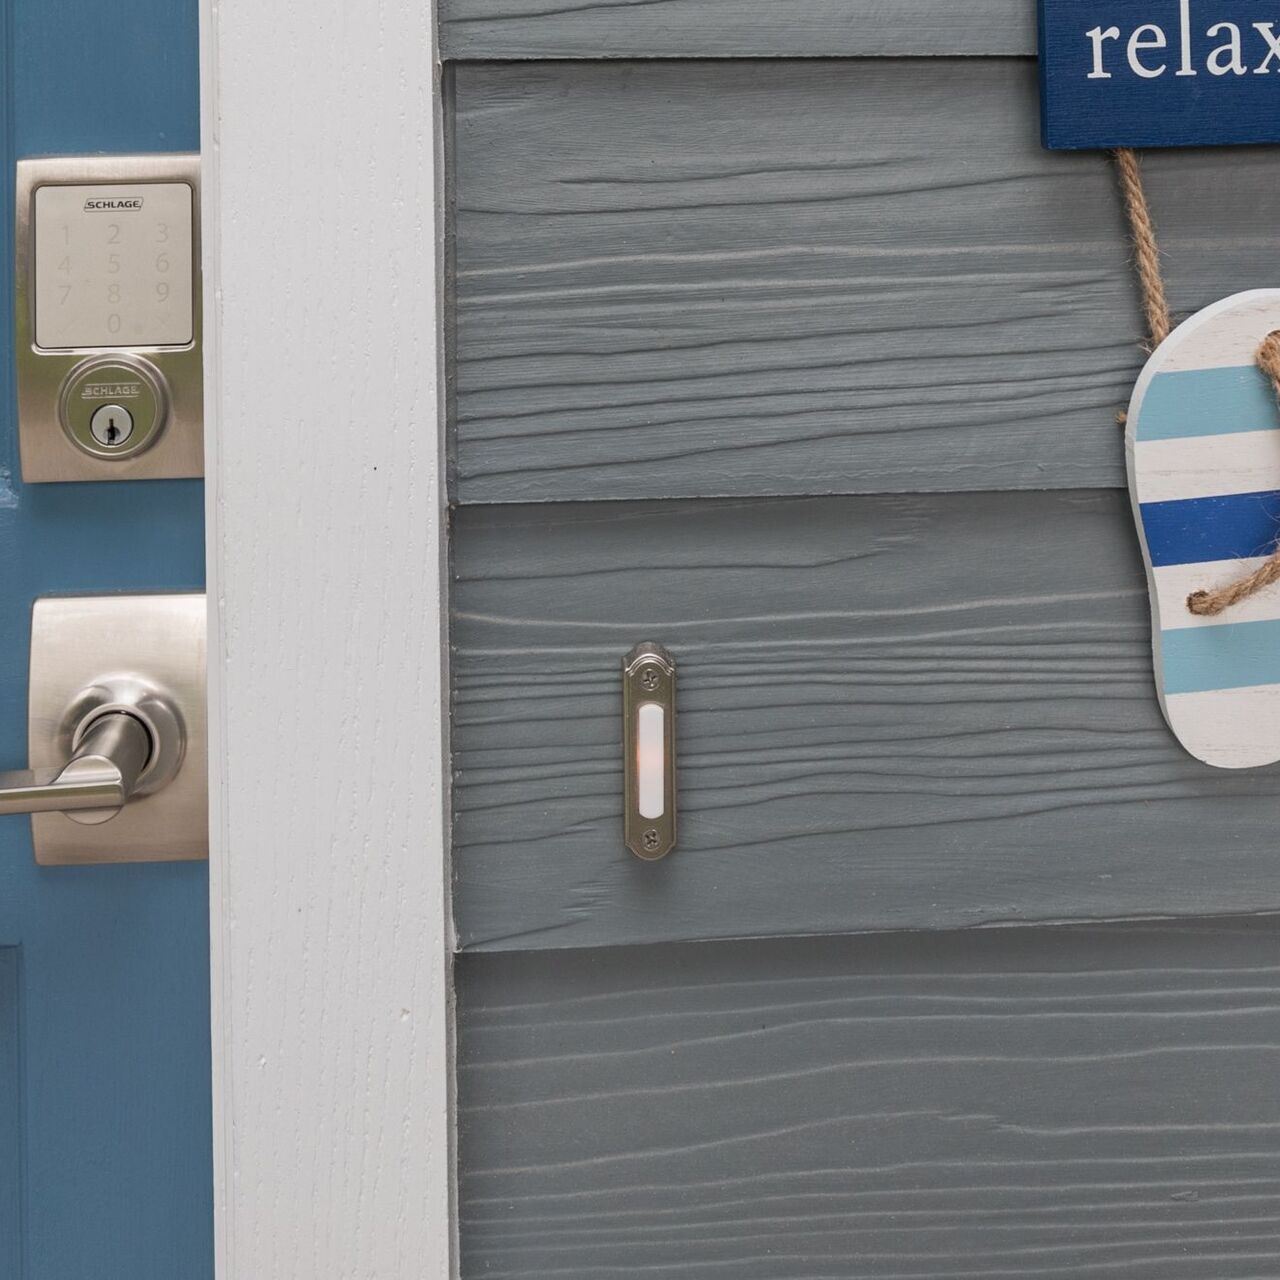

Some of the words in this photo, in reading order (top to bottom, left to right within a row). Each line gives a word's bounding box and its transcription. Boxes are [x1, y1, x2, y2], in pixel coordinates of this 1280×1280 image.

[86, 200, 141, 210] SCHLAGE
[61, 225, 70, 245] 1
[107, 224, 120, 244] 2
[156, 223, 168, 243] 3
[58, 255, 71, 275] 4
[108, 254, 120, 274] 5
[156, 253, 169, 273] 6
[59, 285, 71, 305] 7
[108, 284, 120, 304] 8
[156, 283, 169, 302] 9
[108, 314, 121, 333] 0
[84, 385, 138, 396] SCHLAGE
